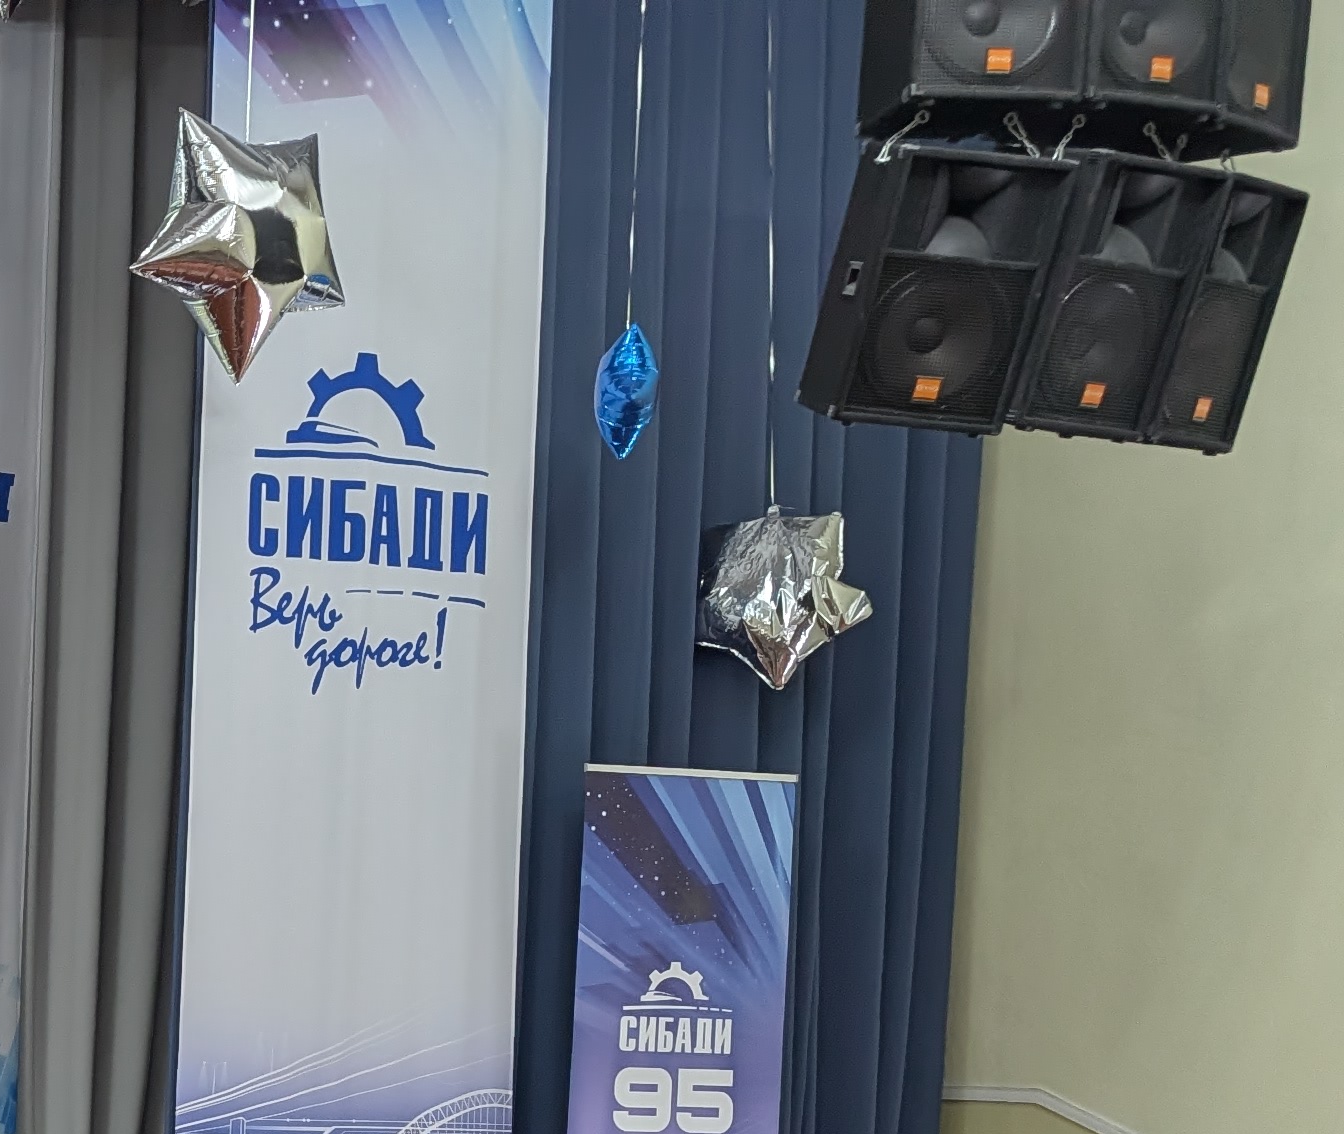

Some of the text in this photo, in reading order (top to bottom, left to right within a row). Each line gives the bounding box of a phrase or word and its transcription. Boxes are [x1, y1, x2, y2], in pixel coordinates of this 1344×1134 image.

[248, 472, 489, 575] СИБАДИ
[249, 566, 343, 650] Верь
[304, 607, 448, 695] дороге!
[619, 1015, 732, 1055] СИБАДИ
[612, 1067, 734, 1134] 95
